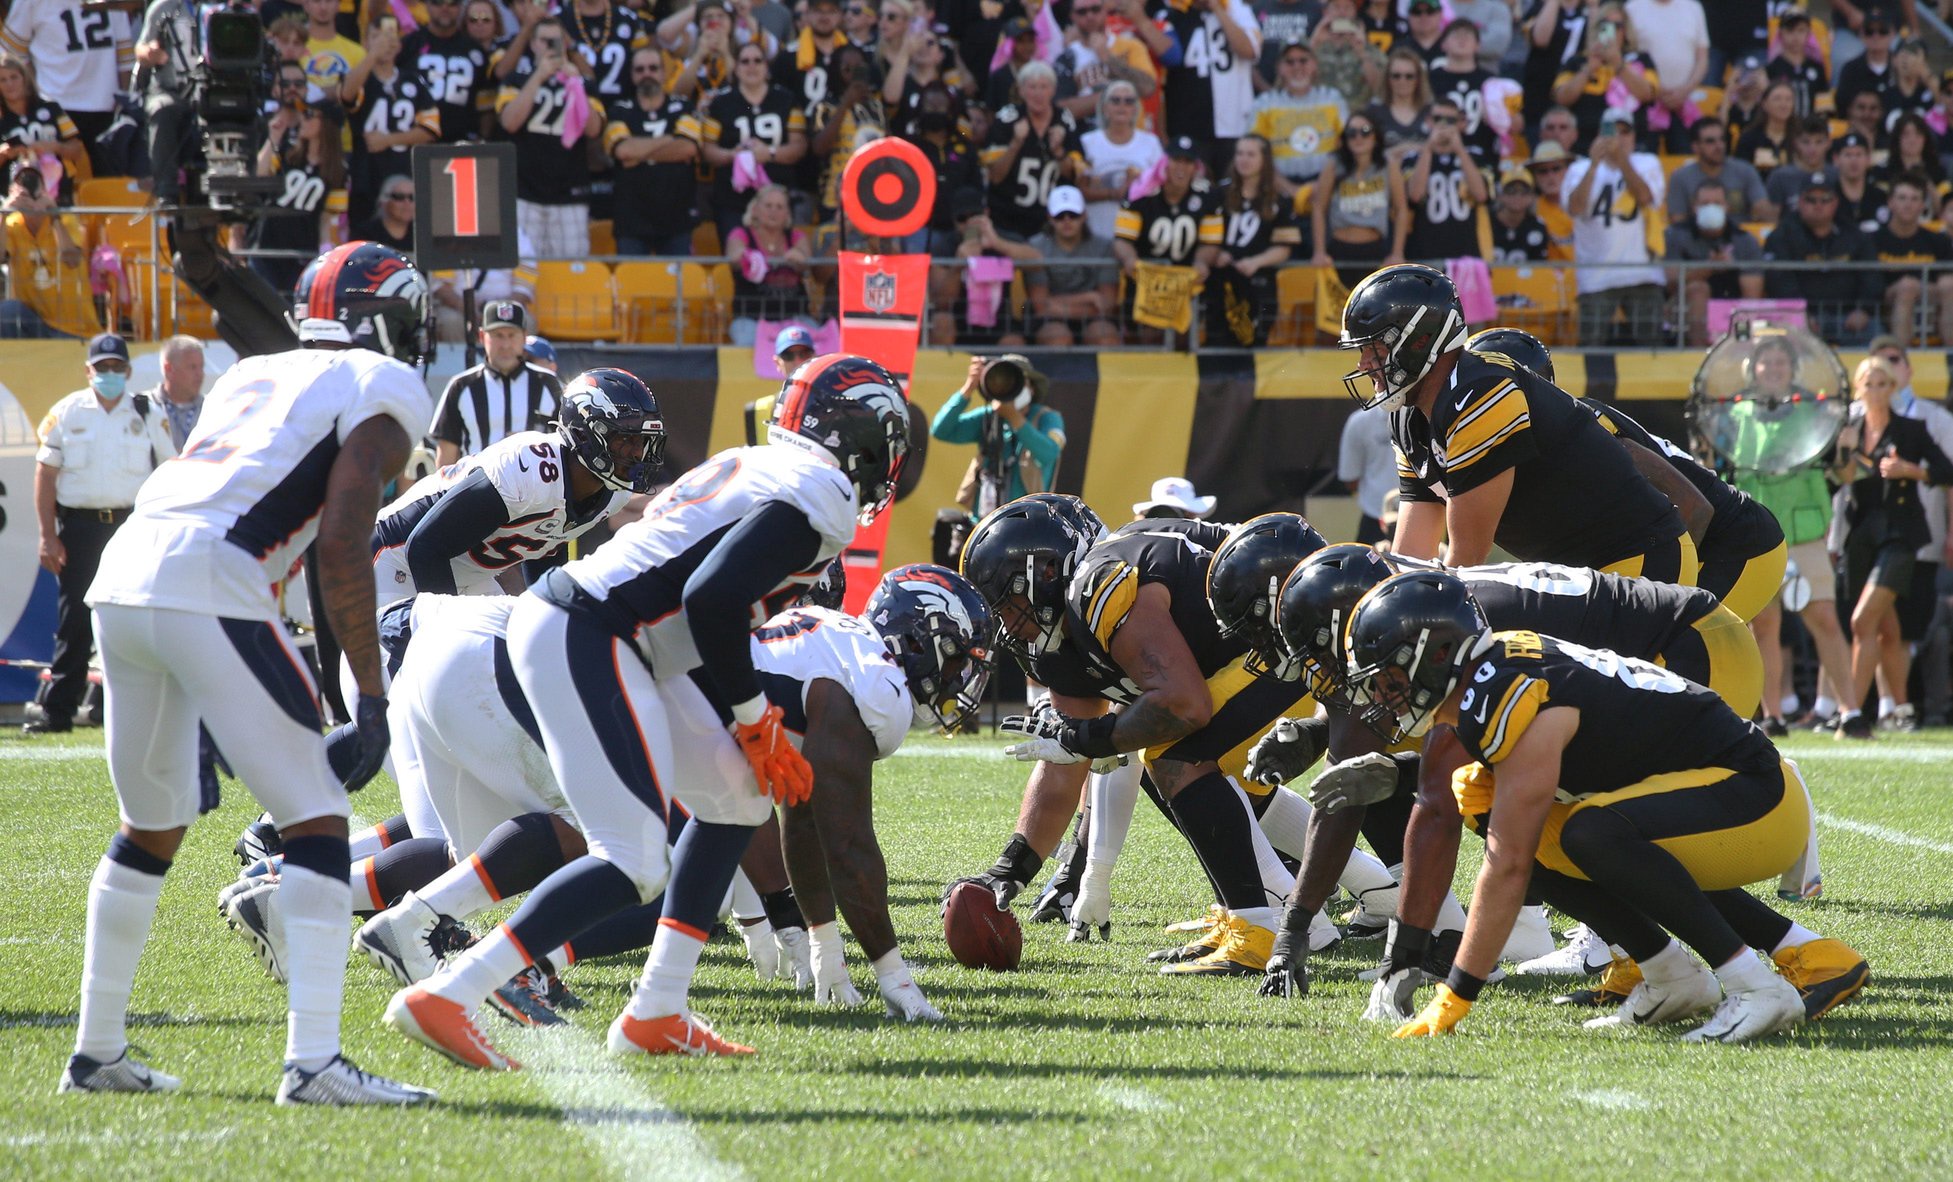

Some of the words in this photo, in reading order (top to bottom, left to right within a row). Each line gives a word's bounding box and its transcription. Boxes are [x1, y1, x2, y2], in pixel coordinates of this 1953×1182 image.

[60, 9, 113, 52] 12
[1184, 26, 1233, 79] 43
[1561, 16, 1587, 64] 7
[418, 54, 474, 106] 32
[734, 113, 783, 151] 19
[277, 169, 325, 212] 90
[444, 157, 479, 237] 1
[1014, 157, 1060, 207] 50
[1427, 171, 1471, 224] 80
[1149, 215, 1197, 261] 90
[1225, 210, 1261, 248] 19
[339, 307, 349, 320] 2
[868, 288, 892, 304] NFL
[171, 378, 277, 465] 2
[803, 415, 819, 428] 59
[529, 442, 560, 484] 58
